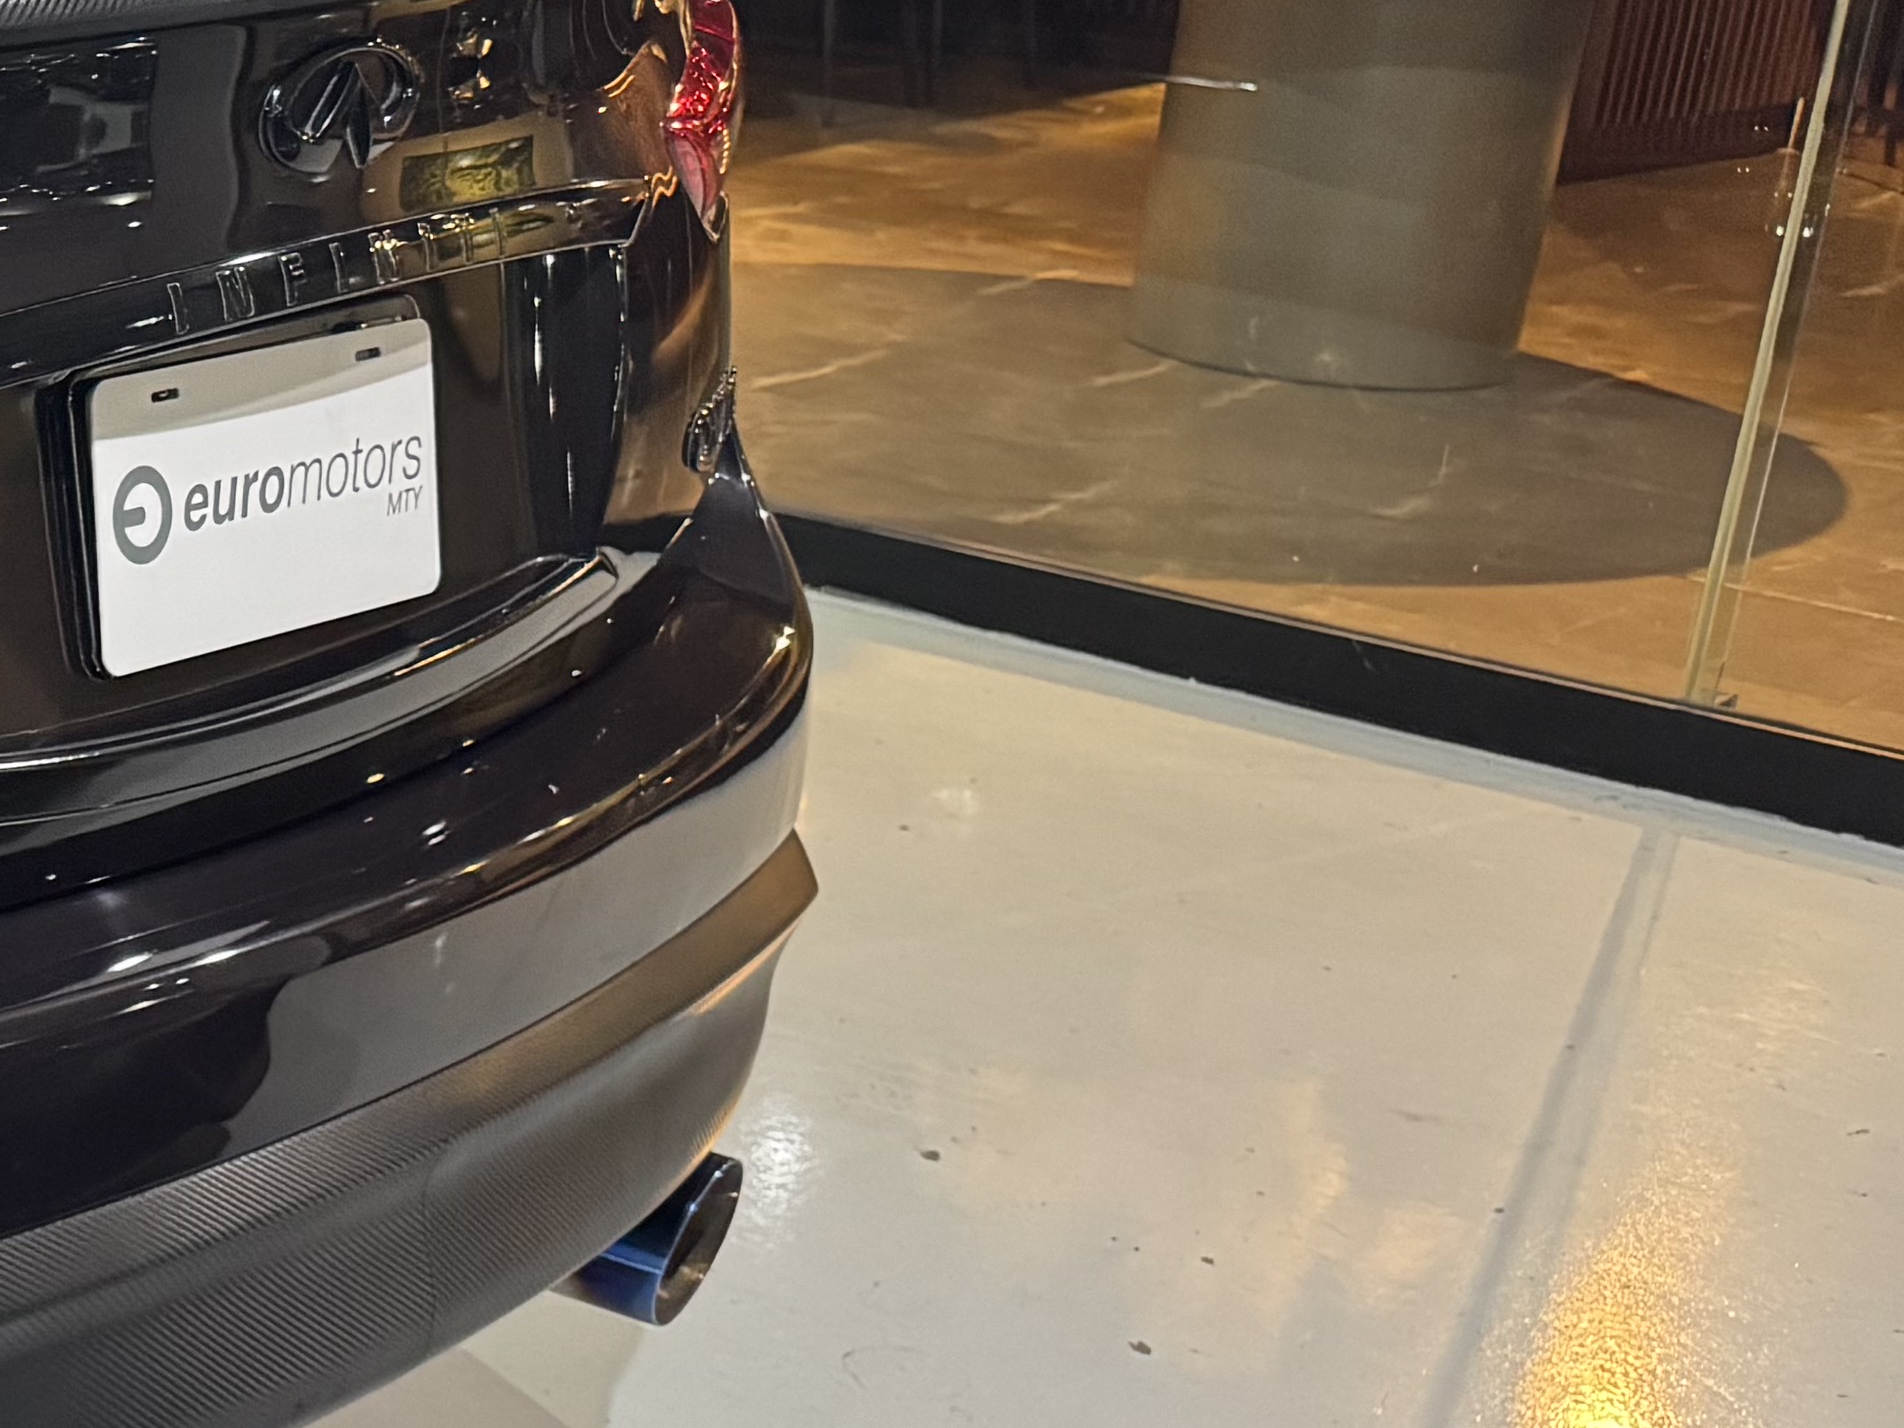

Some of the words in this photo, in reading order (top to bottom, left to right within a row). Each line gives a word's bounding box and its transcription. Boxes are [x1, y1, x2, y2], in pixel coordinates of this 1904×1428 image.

[166, 209, 504, 336] INFINITI
[184, 435, 422, 532] euromotors
[386, 485, 423, 517] MTY
